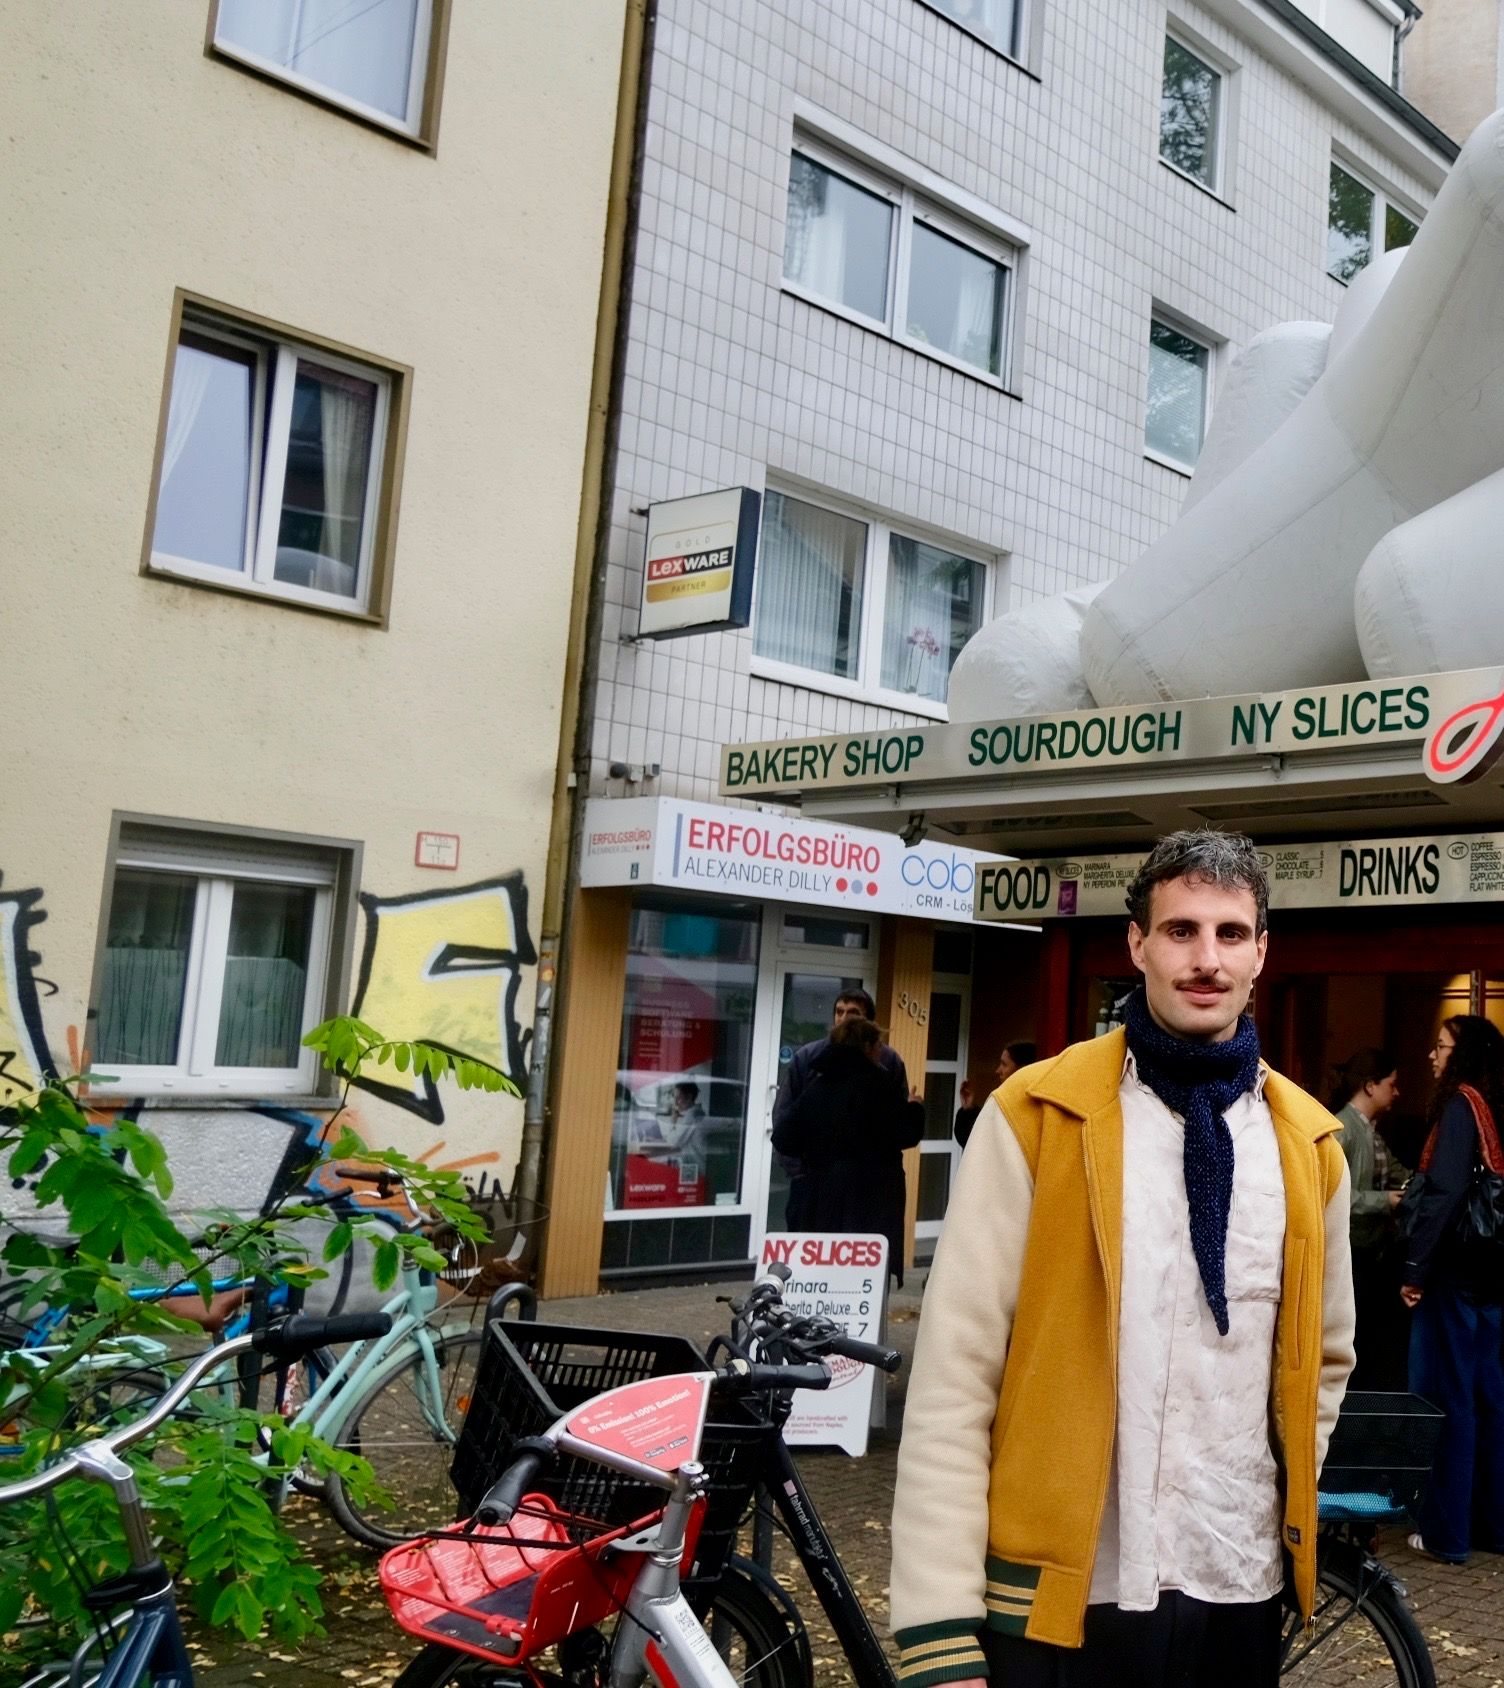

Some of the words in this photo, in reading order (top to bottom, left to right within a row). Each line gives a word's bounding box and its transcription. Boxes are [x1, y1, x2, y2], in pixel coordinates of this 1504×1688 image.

[674, 535, 711, 549] GOLD
[671, 581, 707, 593] PARTNER
[1230, 699, 1281, 747] NY
[1289, 686, 1431, 740] SLICES
[968, 711, 1182, 766] SOURDOUGH
[726, 743, 838, 786] BAKERY
[843, 735, 924, 777] SHOP
[592, 827, 651, 846] ERFOLGSBÜRO
[688, 817, 880, 874] ERFOLGSBÜRO
[684, 855, 783, 888] ALEXANDER
[789, 872, 832, 893] DILLY
[1275, 860, 1309, 871] CHOCOLATE
[1340, 844, 1440, 896] DRINKS
[916, 893, 943, 909] CRM
[978, 865, 1051, 911] FOOD
[900, 991, 929, 1025] 305
[762, 1240, 797, 1264] NY
[800, 1240, 881, 1266] SLICES
[862, 1279, 872, 1294] 5
[815, 1300, 851, 1315] Deluxe
[859, 1301, 869, 1315] 6
[858, 1323, 868, 1337] 7
